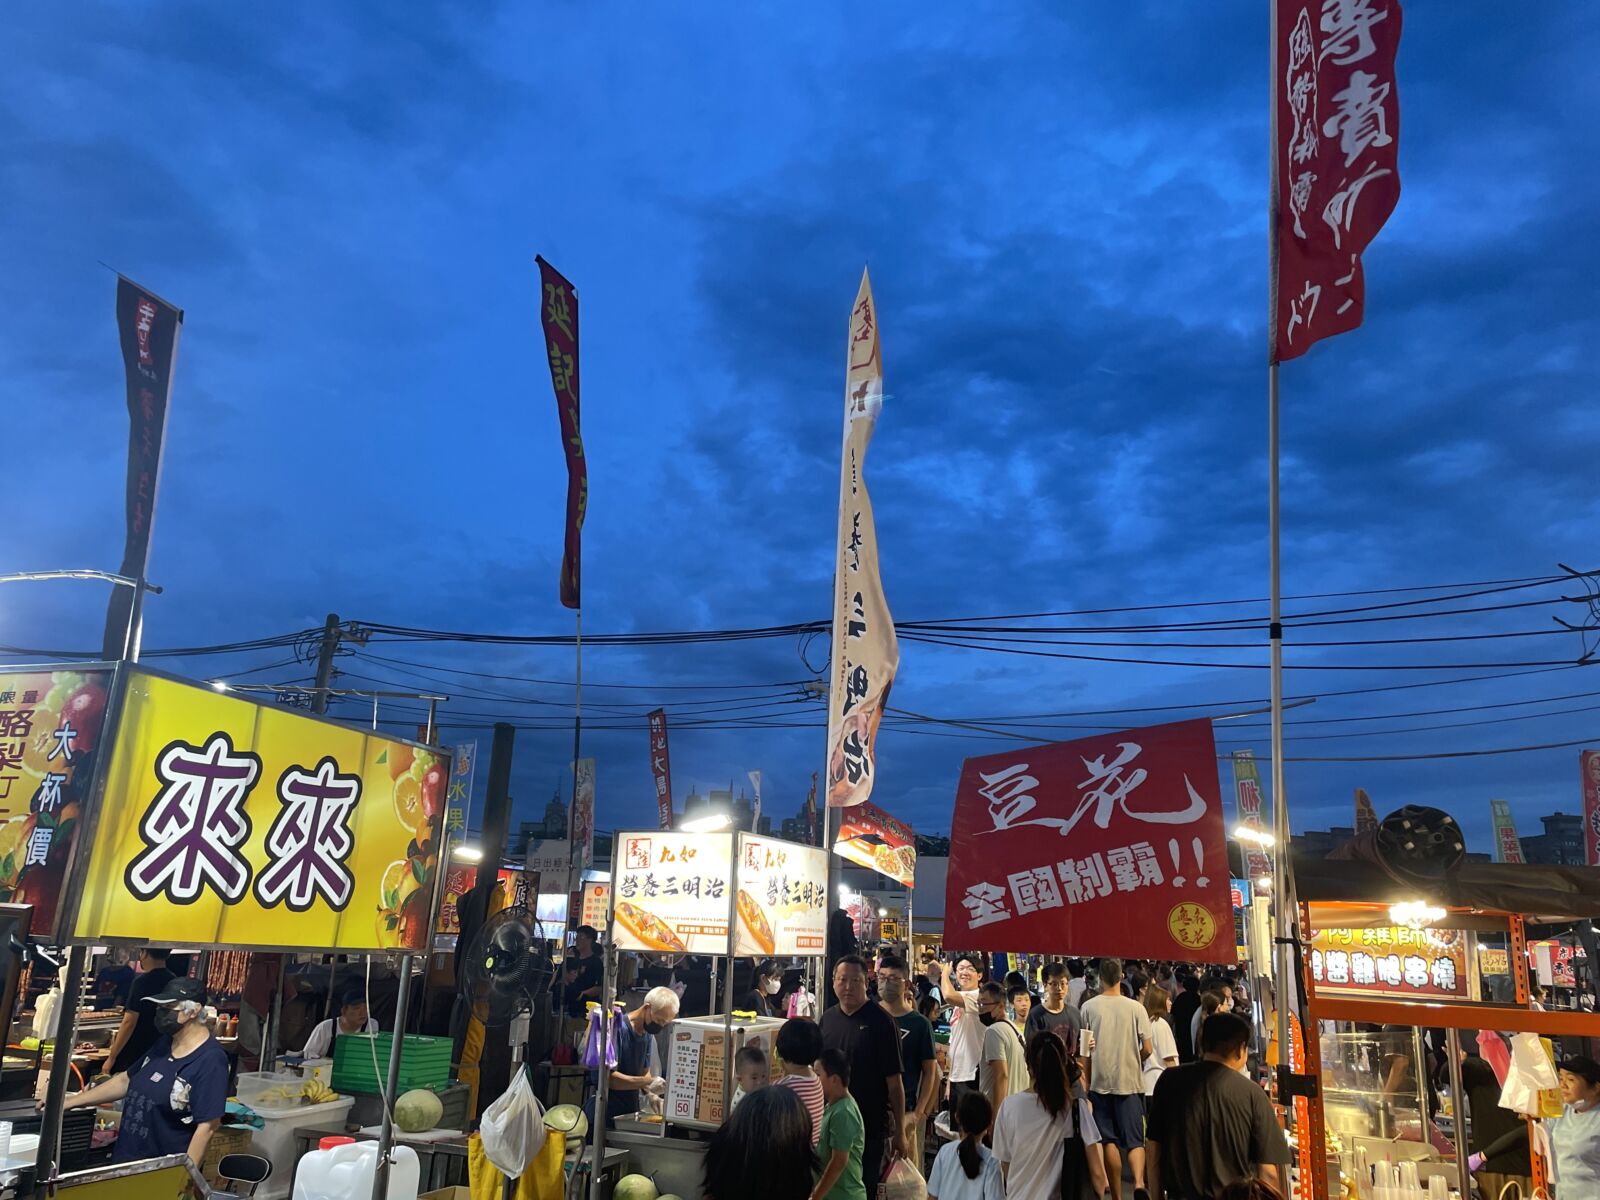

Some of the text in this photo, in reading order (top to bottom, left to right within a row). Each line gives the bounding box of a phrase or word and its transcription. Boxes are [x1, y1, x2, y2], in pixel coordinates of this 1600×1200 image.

[26, 722, 78, 866] 大杯價
[972, 742, 1207, 836] 豆花
[659, 845, 697, 864] 九如
[620, 872, 725, 900] 營養三明治
[766, 874, 824, 909] 營養三明治
[677, 1103, 689, 1113] 50
